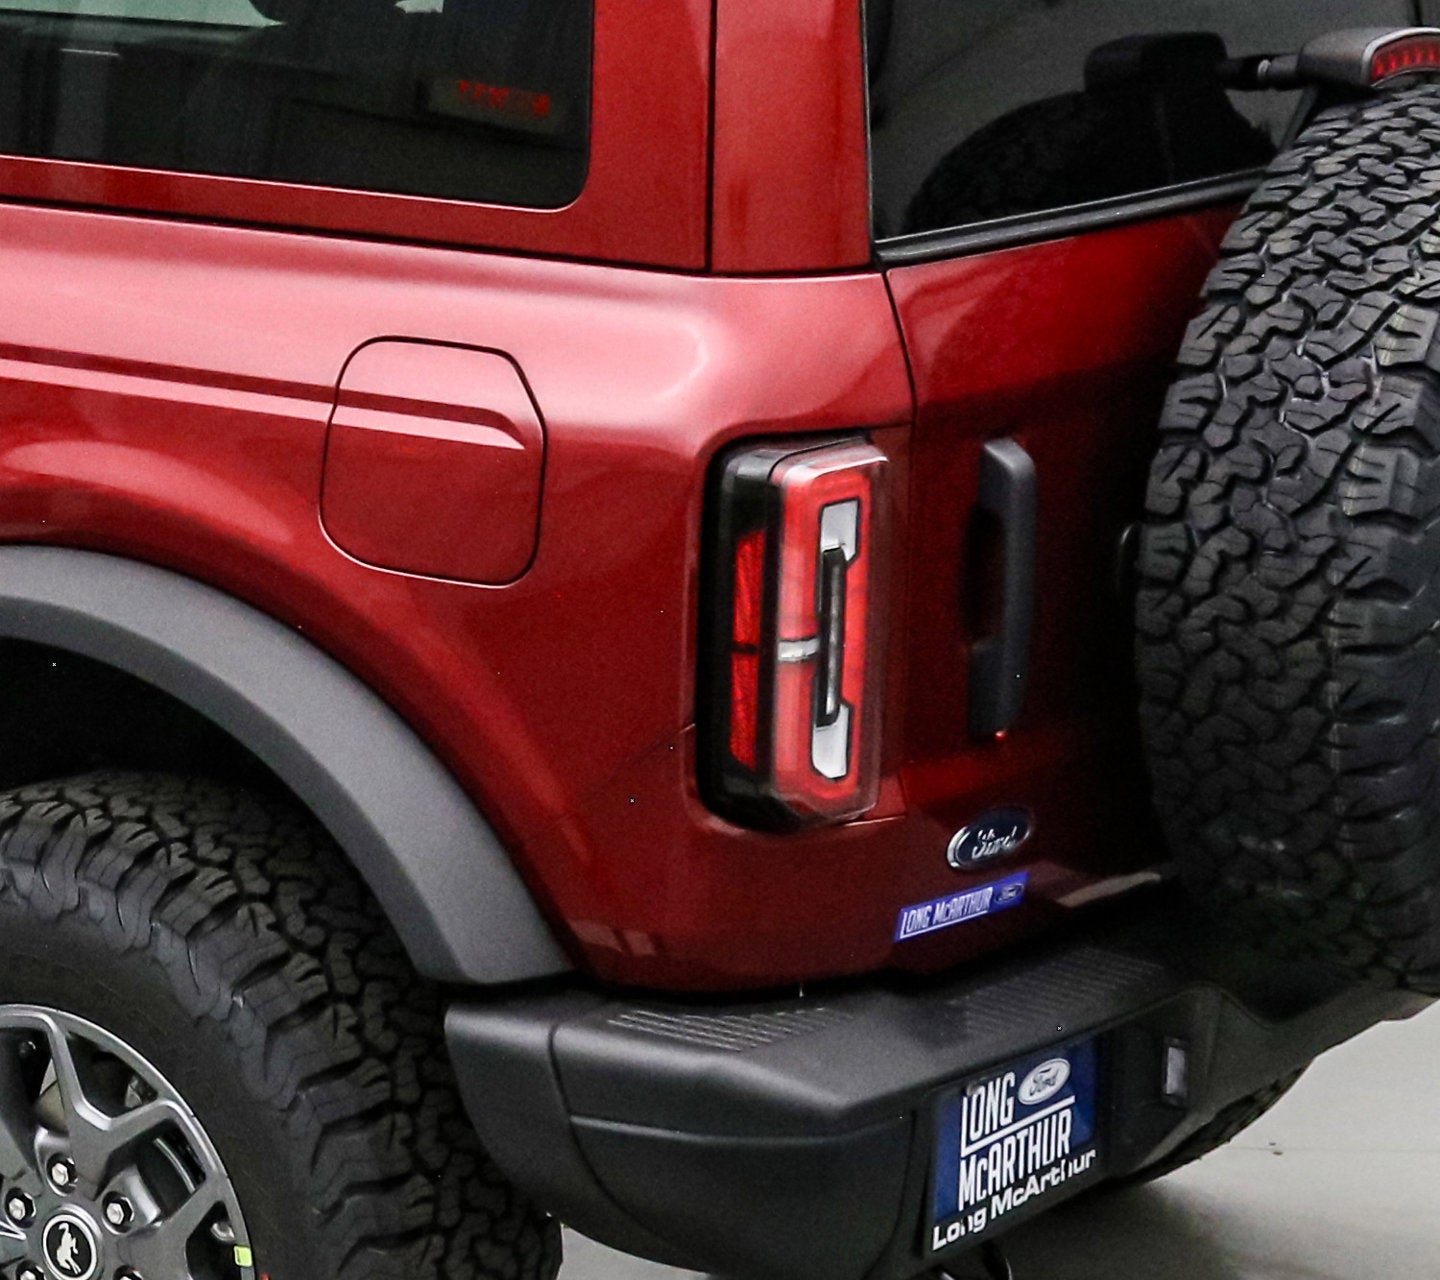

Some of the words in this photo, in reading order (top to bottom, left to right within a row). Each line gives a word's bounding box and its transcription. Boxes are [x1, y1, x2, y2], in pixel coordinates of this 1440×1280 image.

[900, 905, 932, 939] LONG
[958, 1108, 1073, 1212] McARTHUR
[961, 1071, 1016, 1158] LONG
[932, 1207, 988, 1251] Long
[990, 1148, 1097, 1220] McArthur
